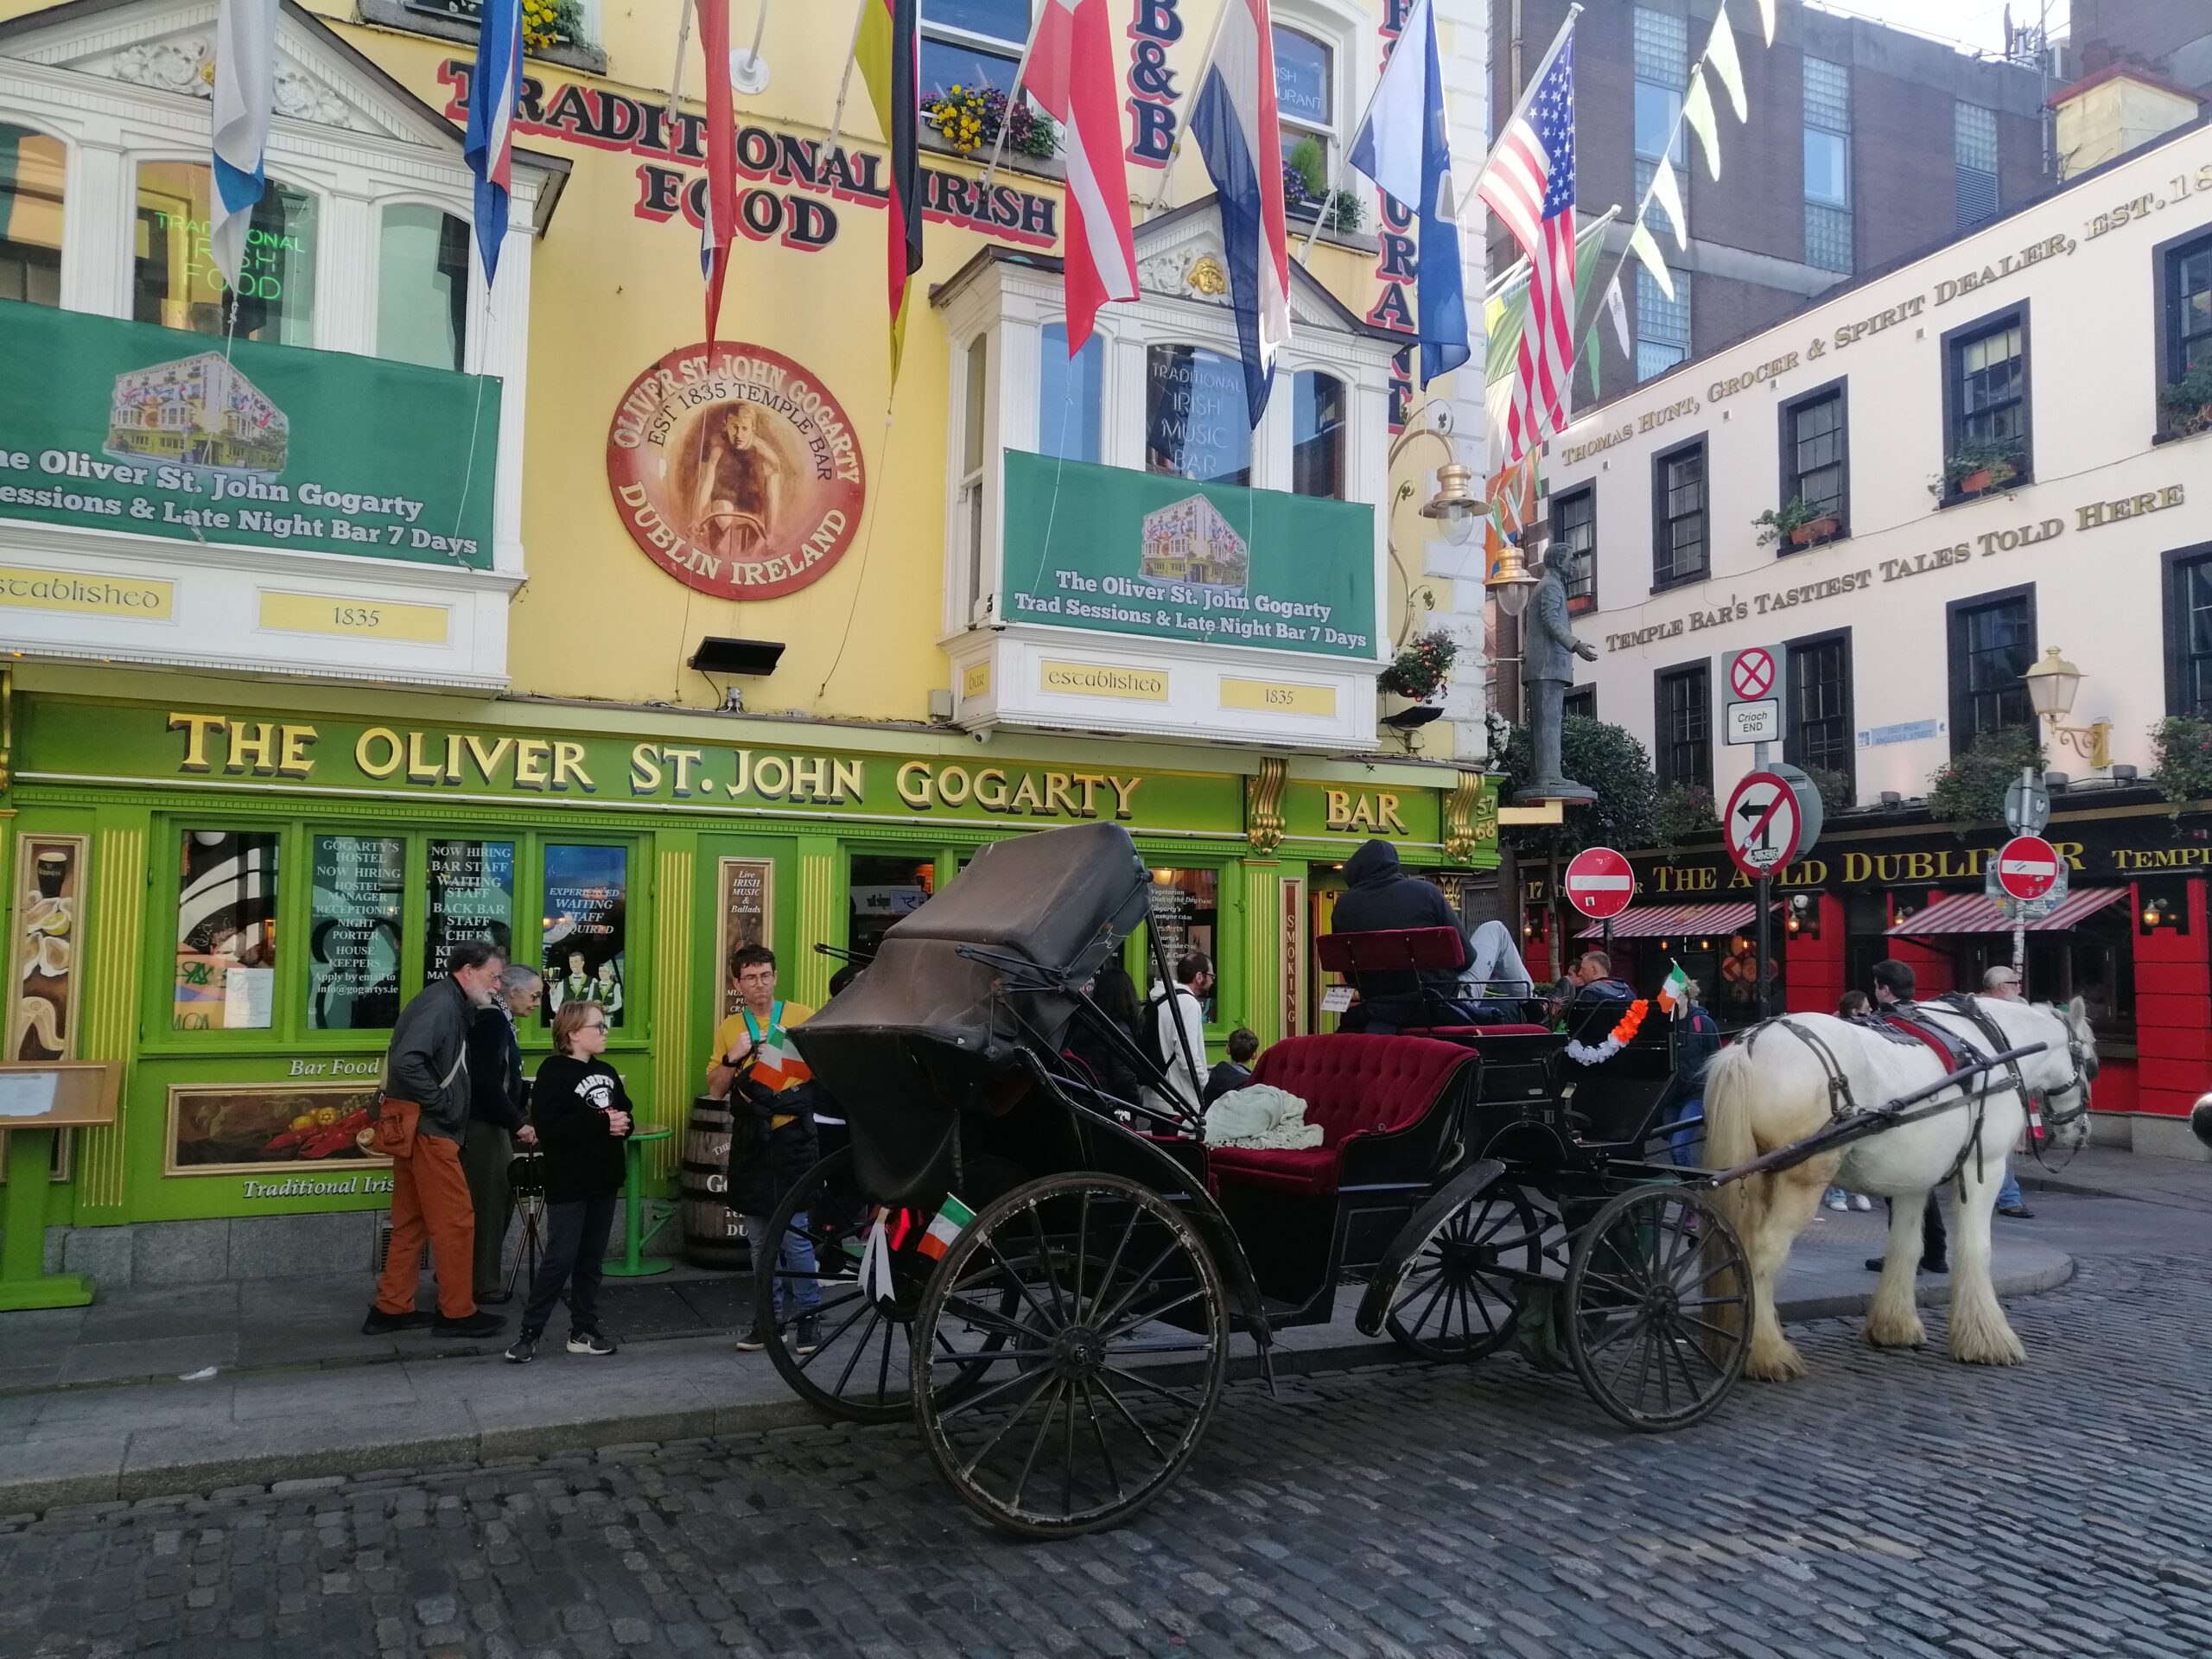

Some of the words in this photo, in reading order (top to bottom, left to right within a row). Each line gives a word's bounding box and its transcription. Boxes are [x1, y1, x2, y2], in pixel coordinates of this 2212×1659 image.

[1275, 67, 1296, 83] ISH
[1278, 87, 1321, 111] URANT
[437, 59, 889, 207] TRADITONAL
[920, 167, 1058, 247] IRISH
[155, 212, 306, 253] TRADONAL
[1561, 423, 1633, 467] THOMAS
[1637, 396, 1700, 435] HUNT,
[1707, 351, 1799, 403] GROCER
[1806, 338, 1826, 361] &
[1834, 294, 1925, 349] SPIRIT
[1934, 232, 2077, 307] DEALER,
[1153, 362, 1242, 393] TRADITIONAL
[1173, 391, 1221, 416] IRISH
[613, 369, 682, 448] OLIVER
[679, 355, 709, 386] ST
[718, 354, 787, 393] JOHN
[787, 379, 860, 484] GOGARTY
[648, 404, 678, 448] EST
[677, 382, 727, 411] 1835
[733, 382, 814, 435] TEMPLE
[809, 437, 832, 481] BAR
[1161, 417, 1229, 448] MUSIC
[1174, 448, 1217, 474] BAR
[0, 449, 30, 470] he
[39, 449, 149, 486] Oliver
[156, 465, 203, 493] St.
[211, 473, 289, 502] John
[298, 482, 423, 522] Gogarty
[0, 486, 122, 516] essions
[129, 497, 156, 520] &
[162, 501, 230, 529] Late
[237, 509, 324, 539] Night
[330, 518, 381, 543] Bar
[388, 525, 404, 545] 7
[410, 528, 478, 557] Days
[619, 480, 722, 580] DUBLIN
[730, 508, 847, 586] IRELAND
[1605, 618, 1683, 652] TEMPLE
[1688, 594, 1748, 632] BAR'S
[1754, 569, 1872, 615] TASTIEST
[1879, 542, 1971, 582] TALES
[1977, 518, 2065, 557] TOLD
[2075, 483, 2185, 531] HERE
[0, 577, 161, 608] stablished
[1055, 569, 1097, 592] The
[1102, 575, 1166, 601] Oliver
[1170, 585, 1198, 605] St.
[1203, 588, 1250, 611] John
[1255, 594, 1332, 622] Gogarty
[334, 606, 381, 627] 1835
[1014, 592, 1061, 614] Trad
[1065, 598, 1152, 625] Sessions
[1155, 610, 1172, 627] &
[1175, 612, 1216, 632] Late
[1219, 616, 1272, 639] Night
[1275, 622, 1306, 641] Bar
[1310, 626, 1321, 642] 7
[1325, 627, 1367, 650] Days
[1047, 670, 1162, 693] established
[1264, 688, 1294, 705] 1835
[1738, 710, 1768, 723] Críoch
[1743, 722, 1763, 733] END
[167, 712, 320, 779] THE
[354, 727, 596, 793] OLIVER
[630, 743, 714, 798] ST.
[726, 749, 864, 804] JOHN
[896, 760, 1143, 820] GOGARTY
[1325, 789, 1409, 836] BAR
[1477, 795, 1497, 816] 57
[1477, 820, 1496, 841] 58
[322, 840, 400, 853] GOGARTY'S
[432, 846, 462, 856] NOW
[467, 848, 511, 858] HIRING
[335, 852, 387, 863] HOSTEL
[317, 866, 348, 876] NOW
[354, 868, 401, 879] HIRING
[432, 861, 461, 872] BAR
[465, 861, 508, 873] STAFF
[739, 870, 755, 879] Live
[1653, 866, 1717, 892] THE
[1728, 859, 1827, 888] ALD
[1841, 842, 2086, 883] DUBLIR
[335, 881, 381, 891] HOSTEL
[436, 875, 501, 888] WAITING
[733, 879, 760, 887] IRISH
[1528, 880, 1544, 899] 17
[328, 893, 388, 902] MANAGER
[446, 887, 491, 899] STAFF
[742, 896, 749, 905] &
[316, 905, 400, 915] RECEPTIONIST
[433, 902, 474, 913] BACK
[477, 905, 505, 914] BAR
[555, 899, 613, 909] WAITING
[731, 905, 761, 913] Ballads
[337, 918, 376, 928] NIGHT
[447, 916, 491, 926] STAFF
[332, 931, 379, 940] PORTER
[445, 931, 492, 942] CHEFS
[336, 945, 375, 956] HOUSE
[329, 958, 381, 969] KEEPERS
[1287, 915, 1295, 1022] SMOKING
[313, 973, 343, 983] Apply
[346, 974, 357, 983] by
[359, 973, 385, 982] email
[318, 984, 399, 995] info@gogartys.ie
[288, 1059, 327, 1077] Bar
[329, 1058, 379, 1076] Food
[574, 1074, 614, 1098] NARUTO
[712, 1142, 731, 1156] THE
[243, 1177, 358, 1199] Traditional
[361, 1176, 394, 1195] Iris
